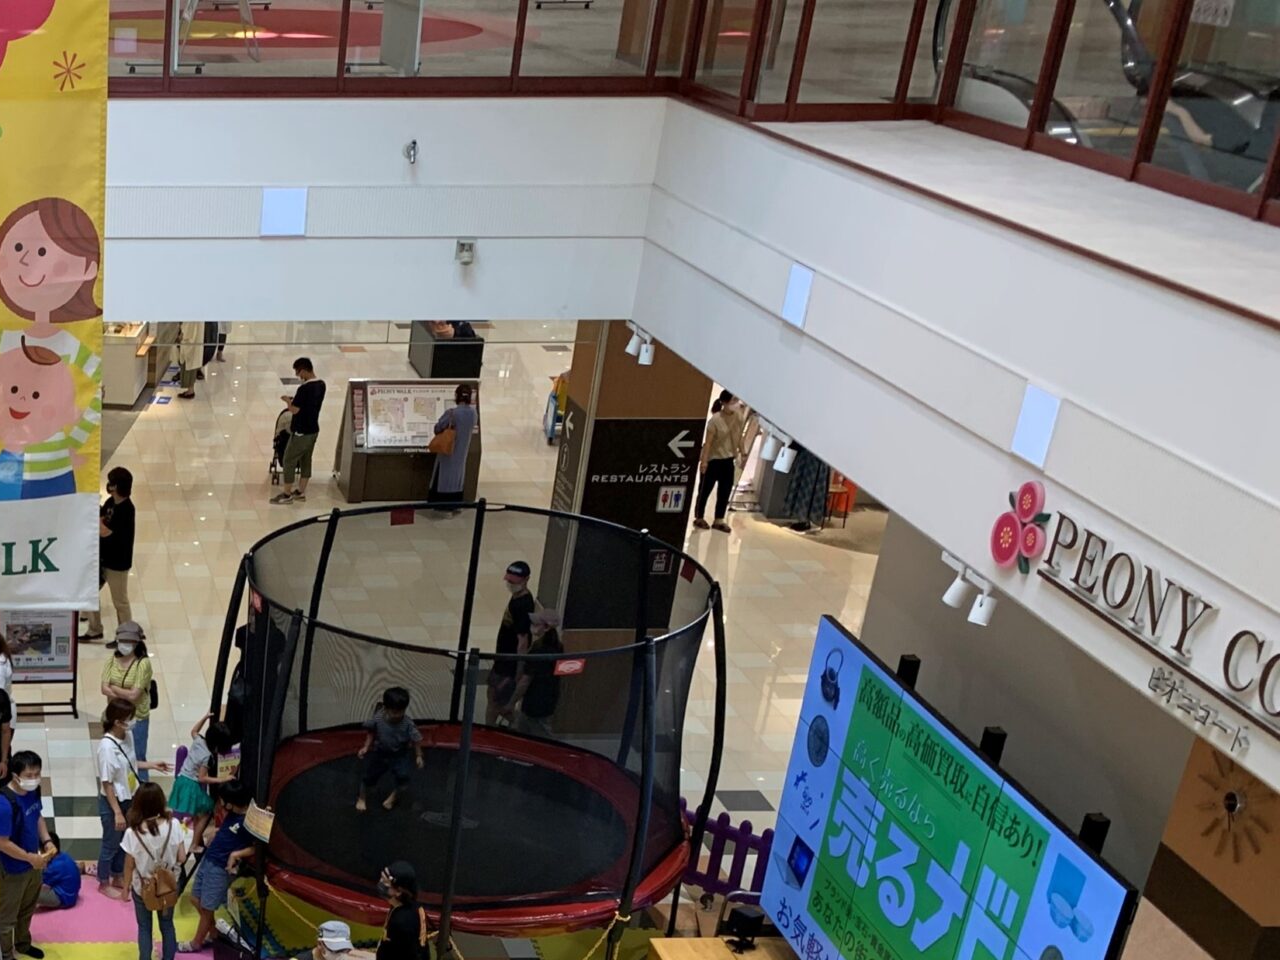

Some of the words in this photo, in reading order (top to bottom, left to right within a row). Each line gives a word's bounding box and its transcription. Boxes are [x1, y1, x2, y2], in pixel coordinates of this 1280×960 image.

[591, 474, 689, 483] RESTAURANTS
[638, 463, 691, 474] レストラン
[1043, 511, 1214, 658] PEONY
[852, 739, 937, 841] 高く売るなら
